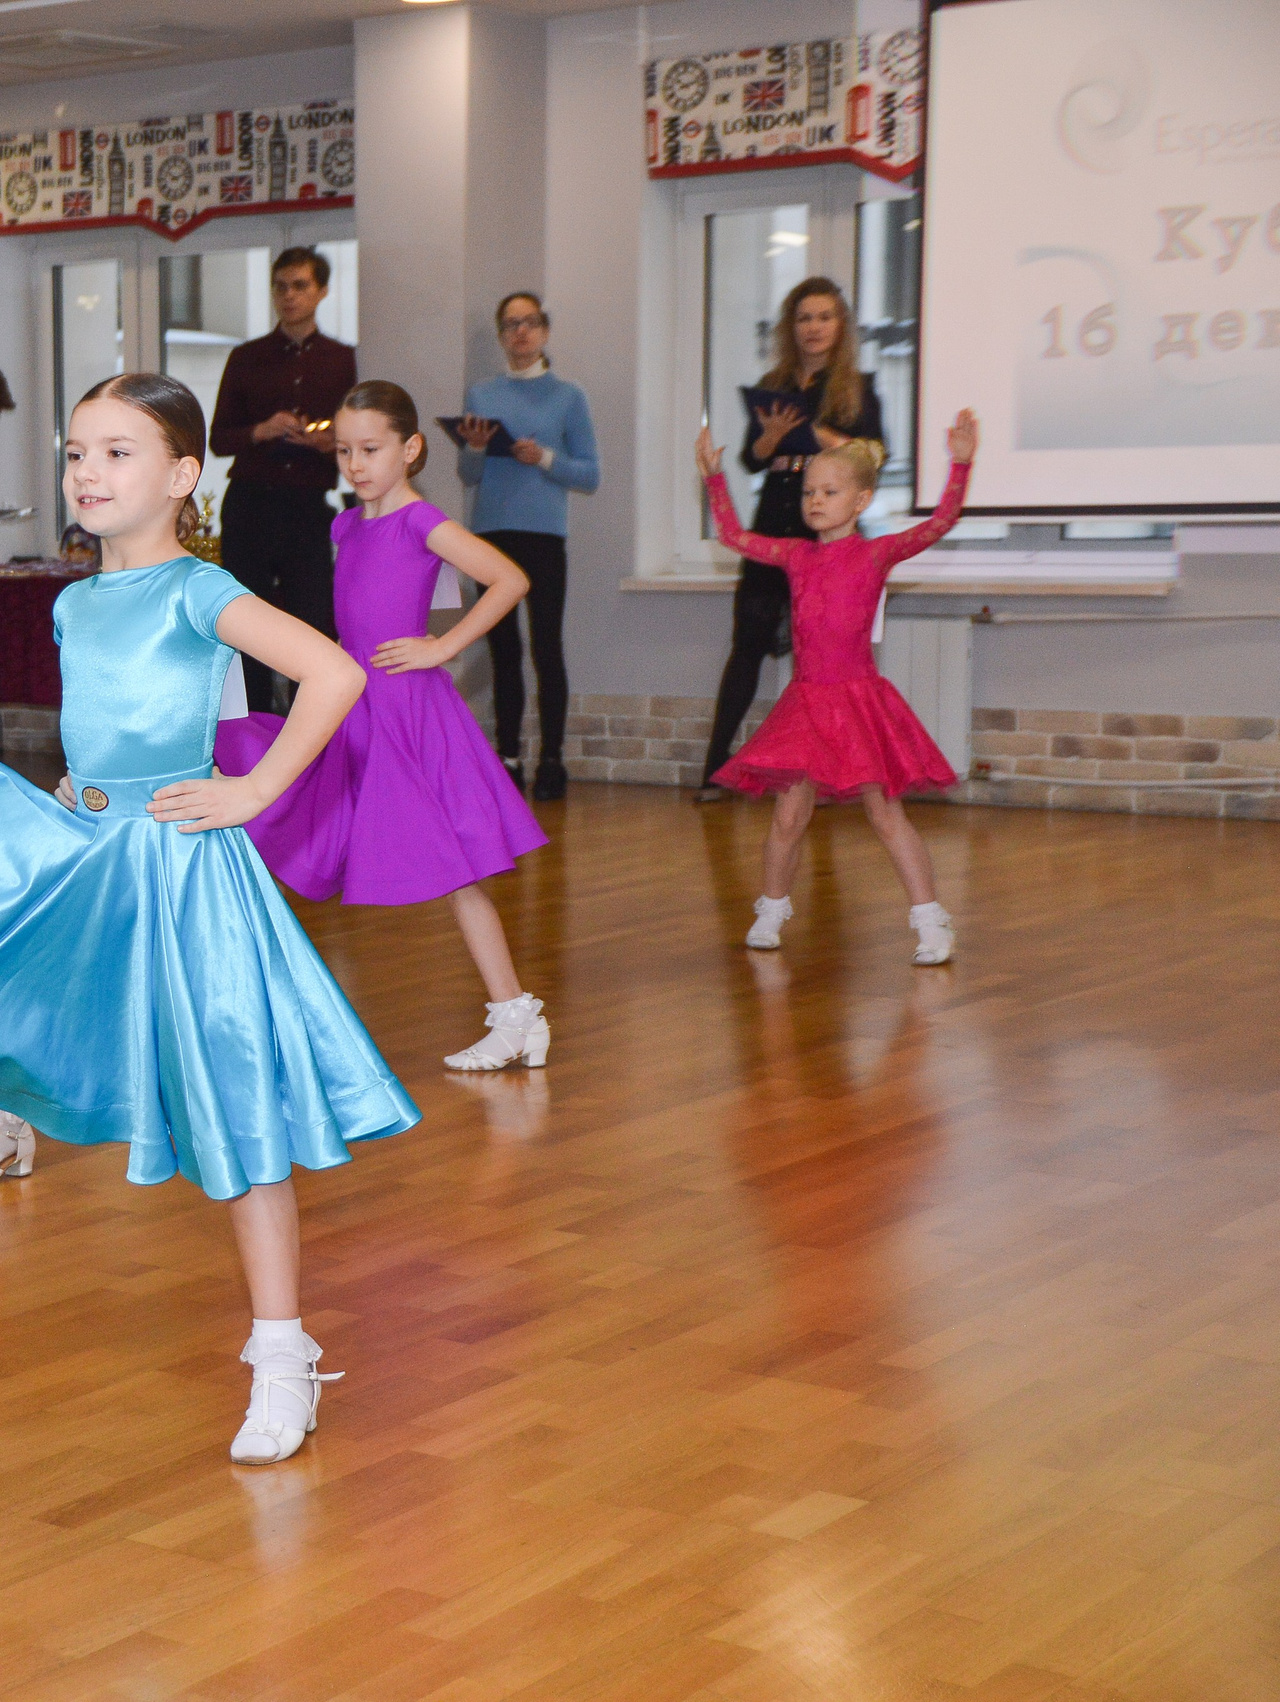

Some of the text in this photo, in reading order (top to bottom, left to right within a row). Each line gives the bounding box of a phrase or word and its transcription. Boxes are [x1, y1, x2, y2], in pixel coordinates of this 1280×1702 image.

[288, 109, 354, 131] LONDON
[723, 111, 805, 135] LONDON
[126, 126, 186, 147] LONDON
[239, 111, 253, 170] LONDON
[806, 124, 837, 146] UK
[189, 138, 208, 157] UK
[34, 156, 52, 172] UK
[1041, 302, 1116, 360] 16
